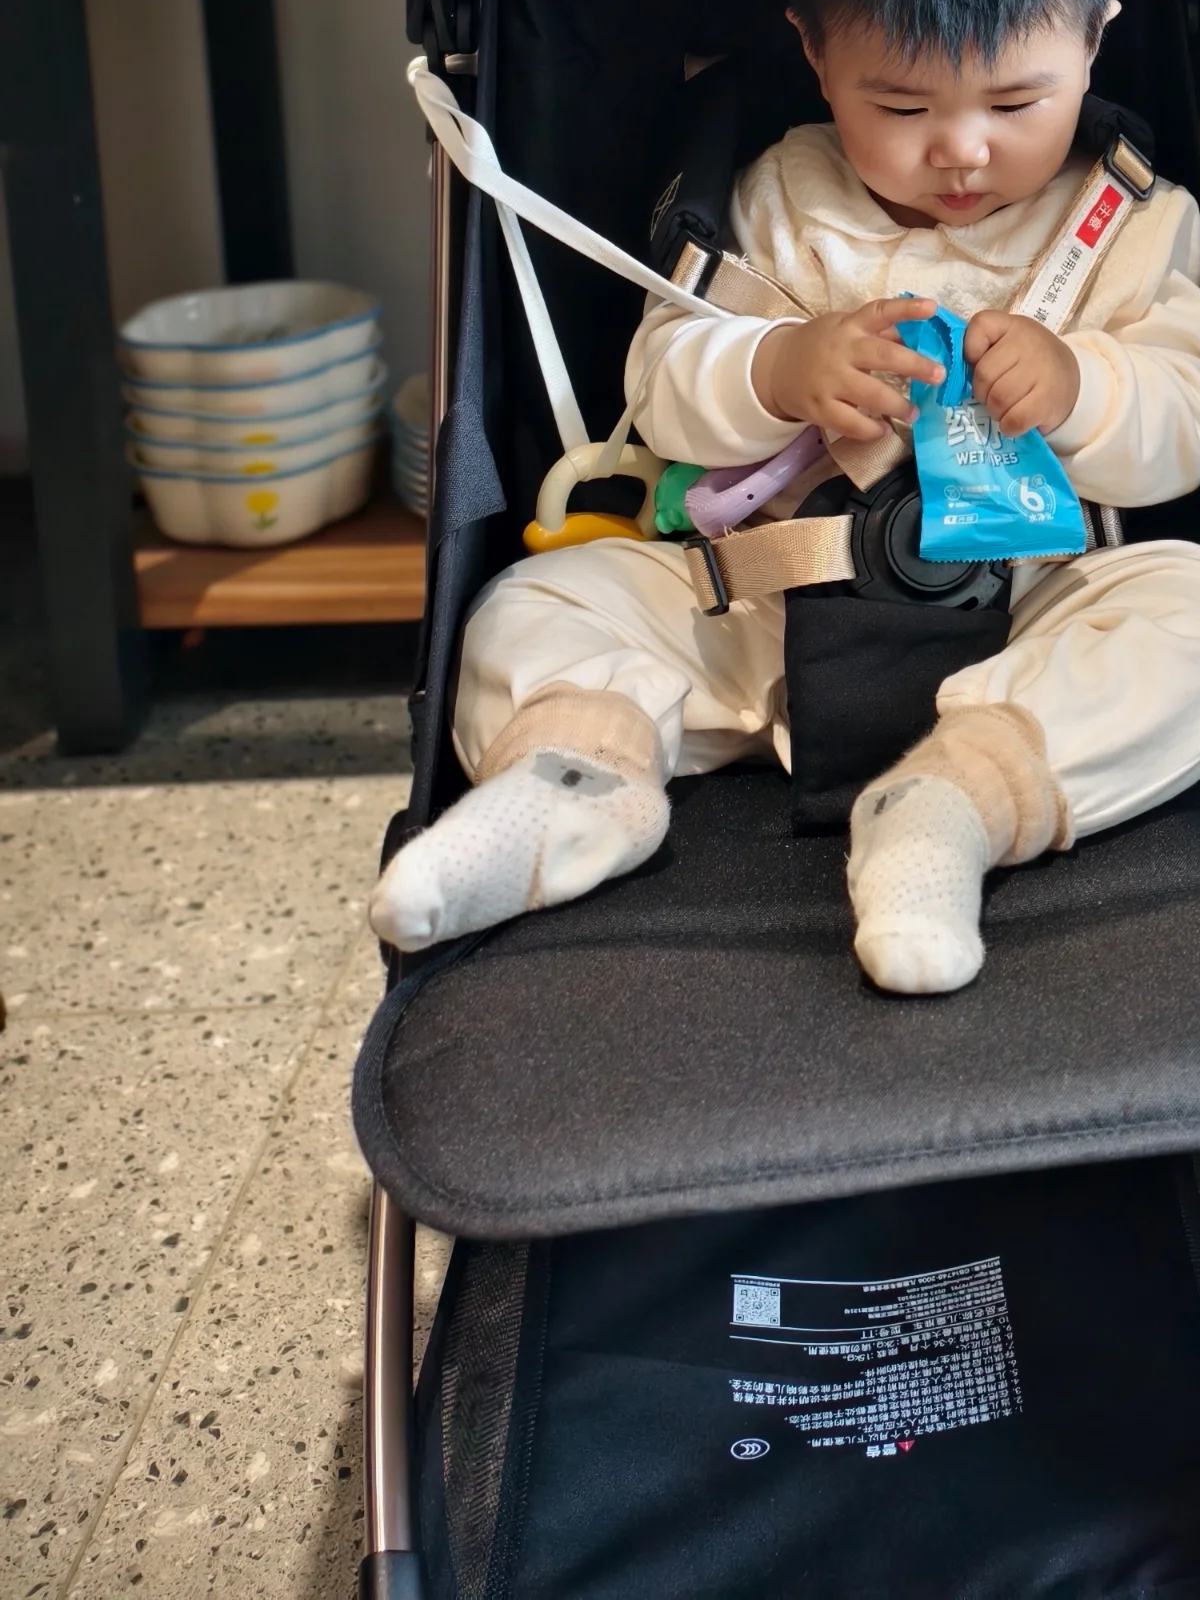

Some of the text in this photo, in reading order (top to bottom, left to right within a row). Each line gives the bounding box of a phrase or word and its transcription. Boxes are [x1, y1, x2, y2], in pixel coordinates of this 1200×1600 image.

[1088, 200, 1113, 231] 注意
[956, 450, 985, 465] WET
[1020, 477, 1045, 512] 6
[866, 1443, 896, 1458] 警告
